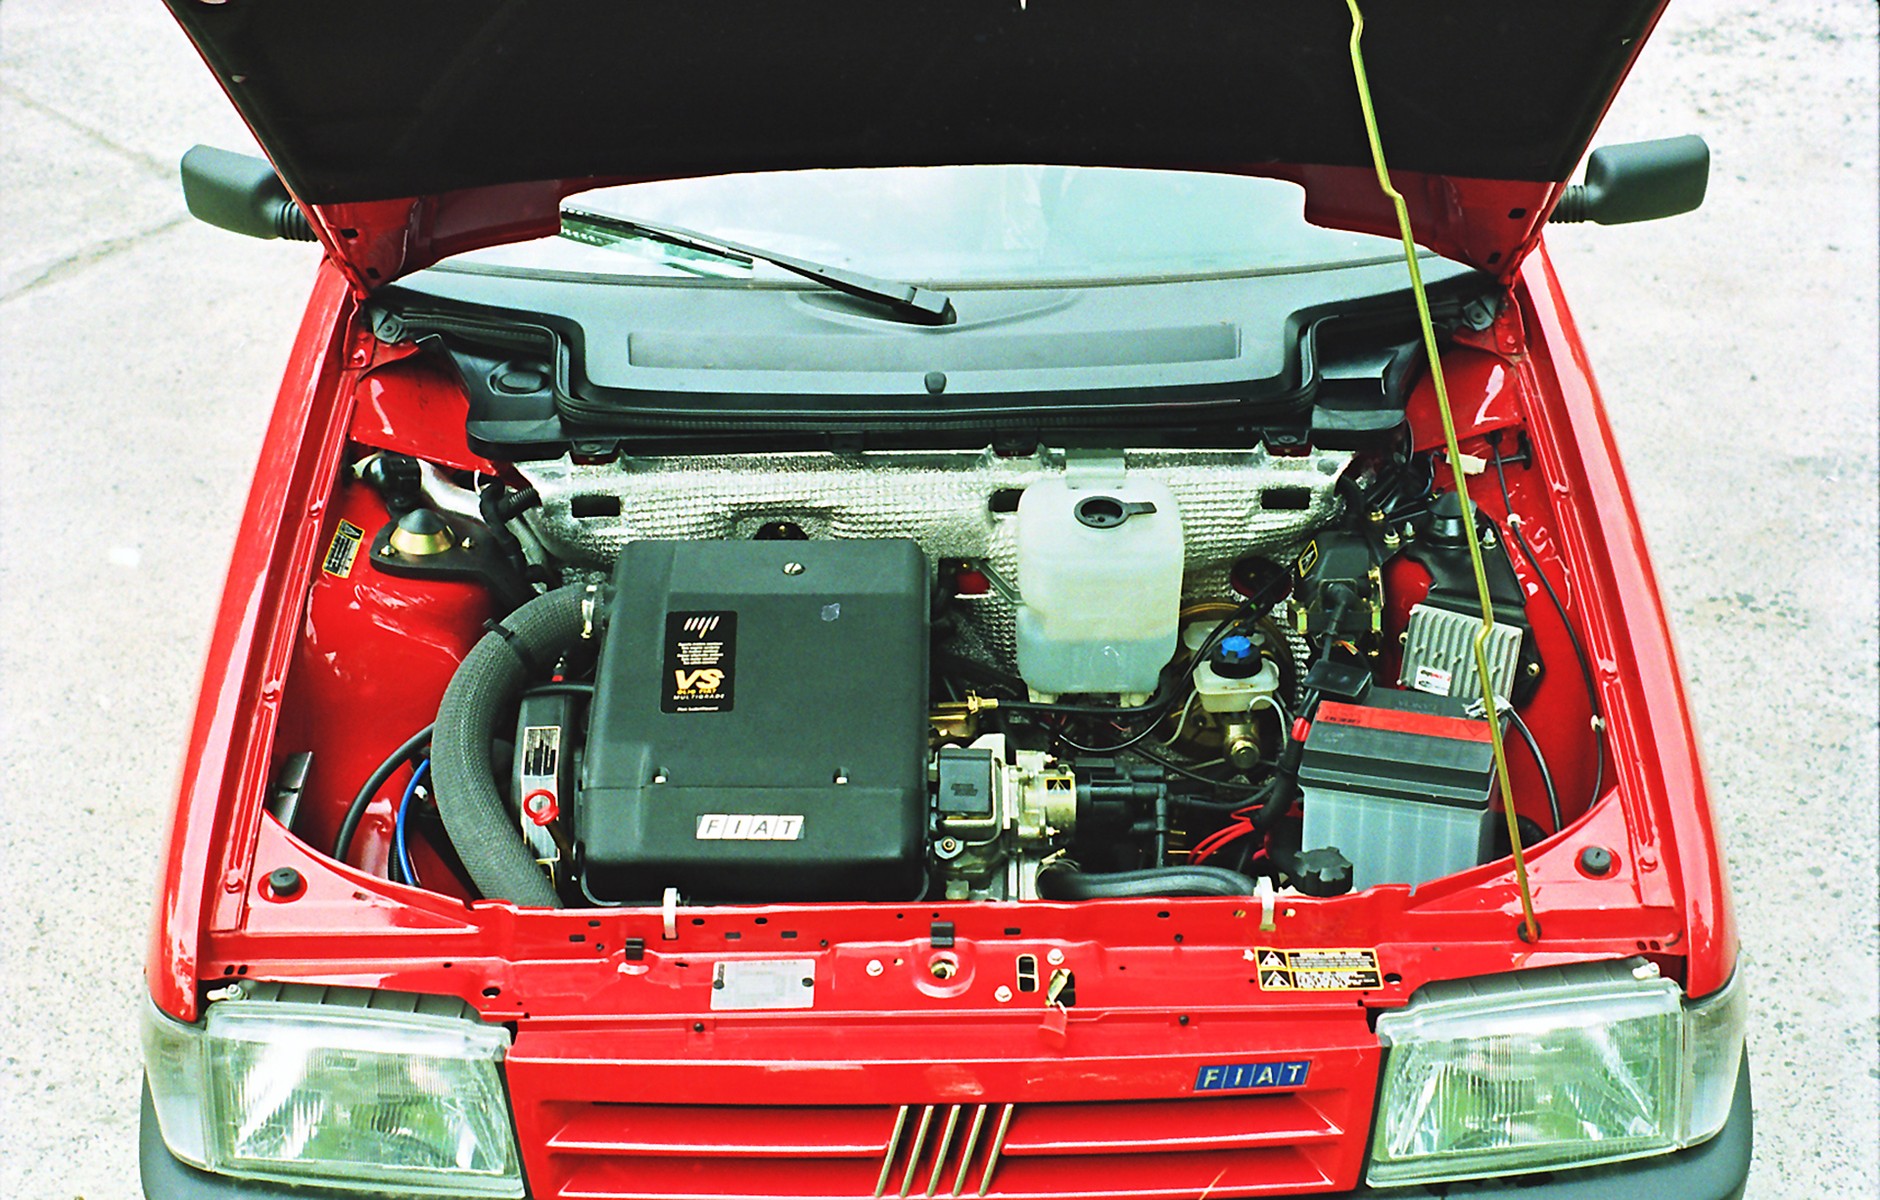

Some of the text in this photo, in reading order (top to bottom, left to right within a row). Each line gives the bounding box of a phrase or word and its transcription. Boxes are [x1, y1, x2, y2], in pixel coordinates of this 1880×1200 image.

[675, 669, 725, 690] VS
[704, 818, 798, 836] FIAT
[1202, 1063, 1303, 1088] FIAT
